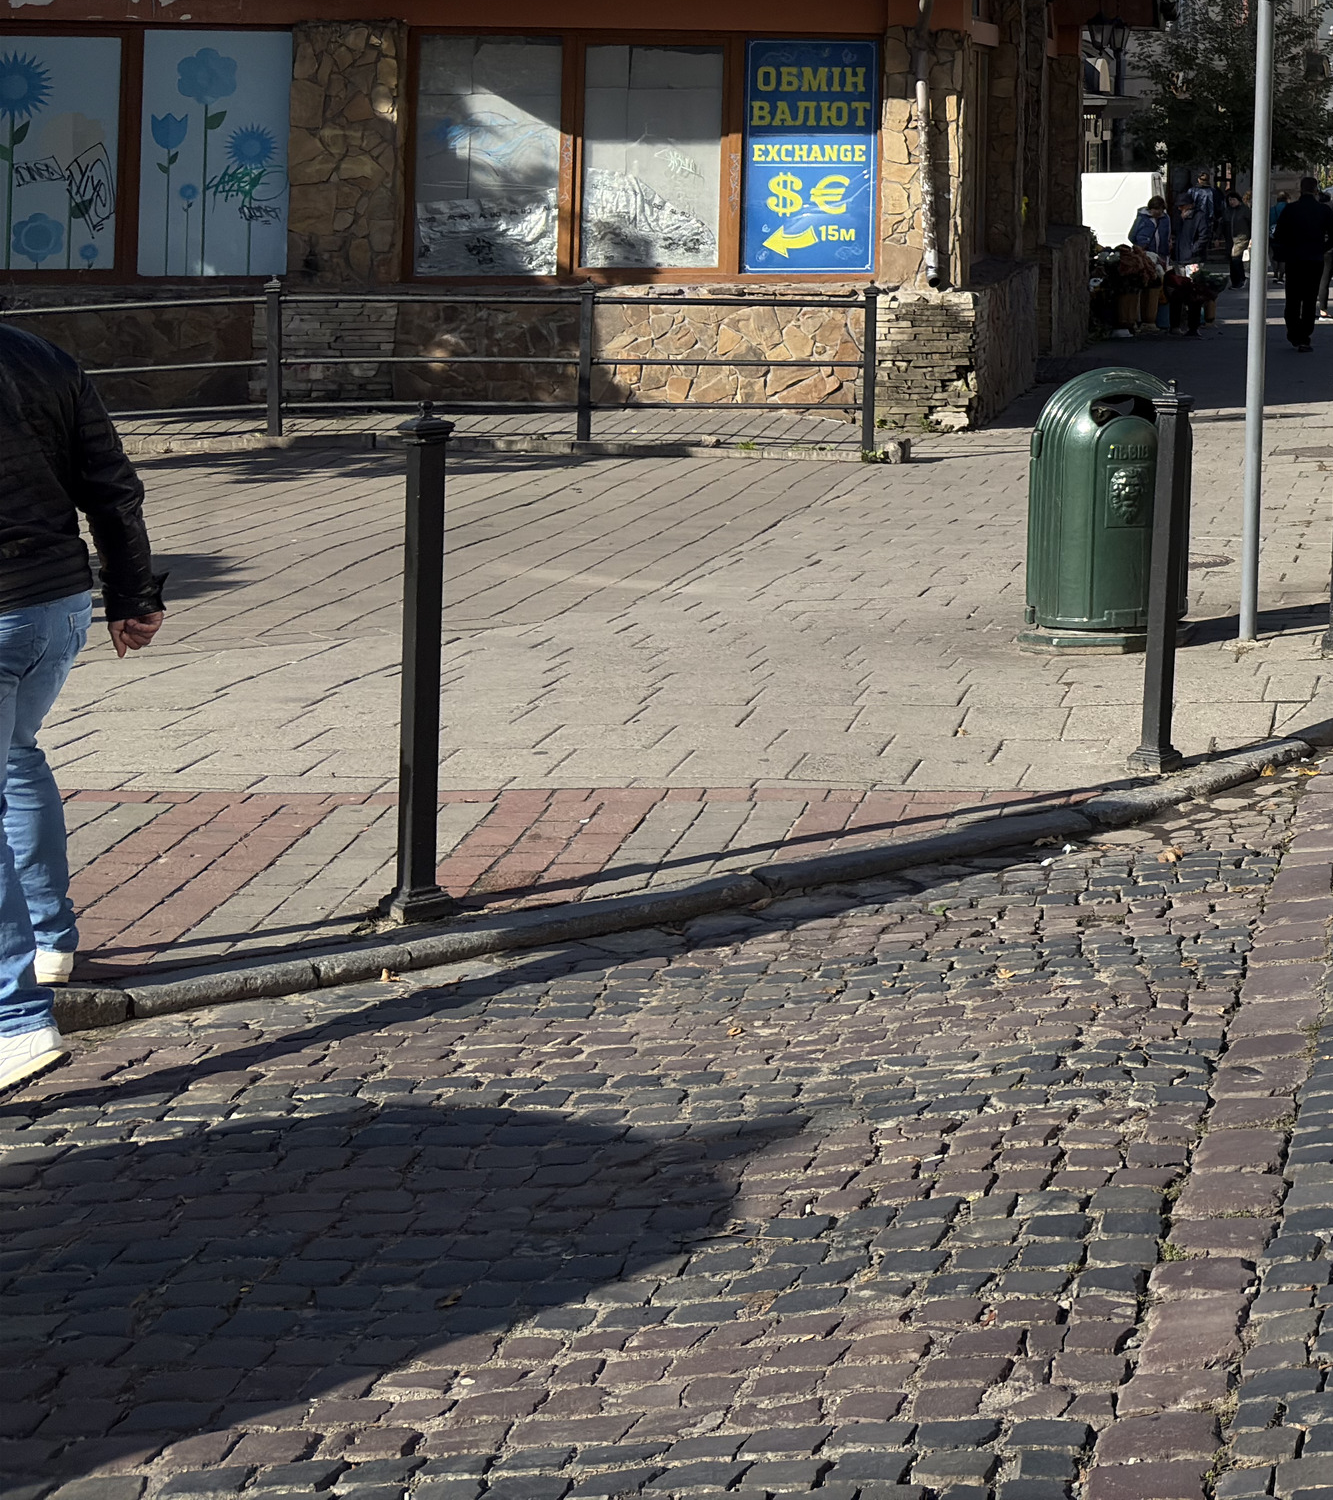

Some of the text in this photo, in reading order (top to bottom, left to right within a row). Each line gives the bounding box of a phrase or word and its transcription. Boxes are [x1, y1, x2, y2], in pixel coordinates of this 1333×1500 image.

[756, 66, 866, 92] ОБМІН
[750, 101, 871, 127] ВАЛЮТ
[752, 144, 866, 162] EXCHANGE
